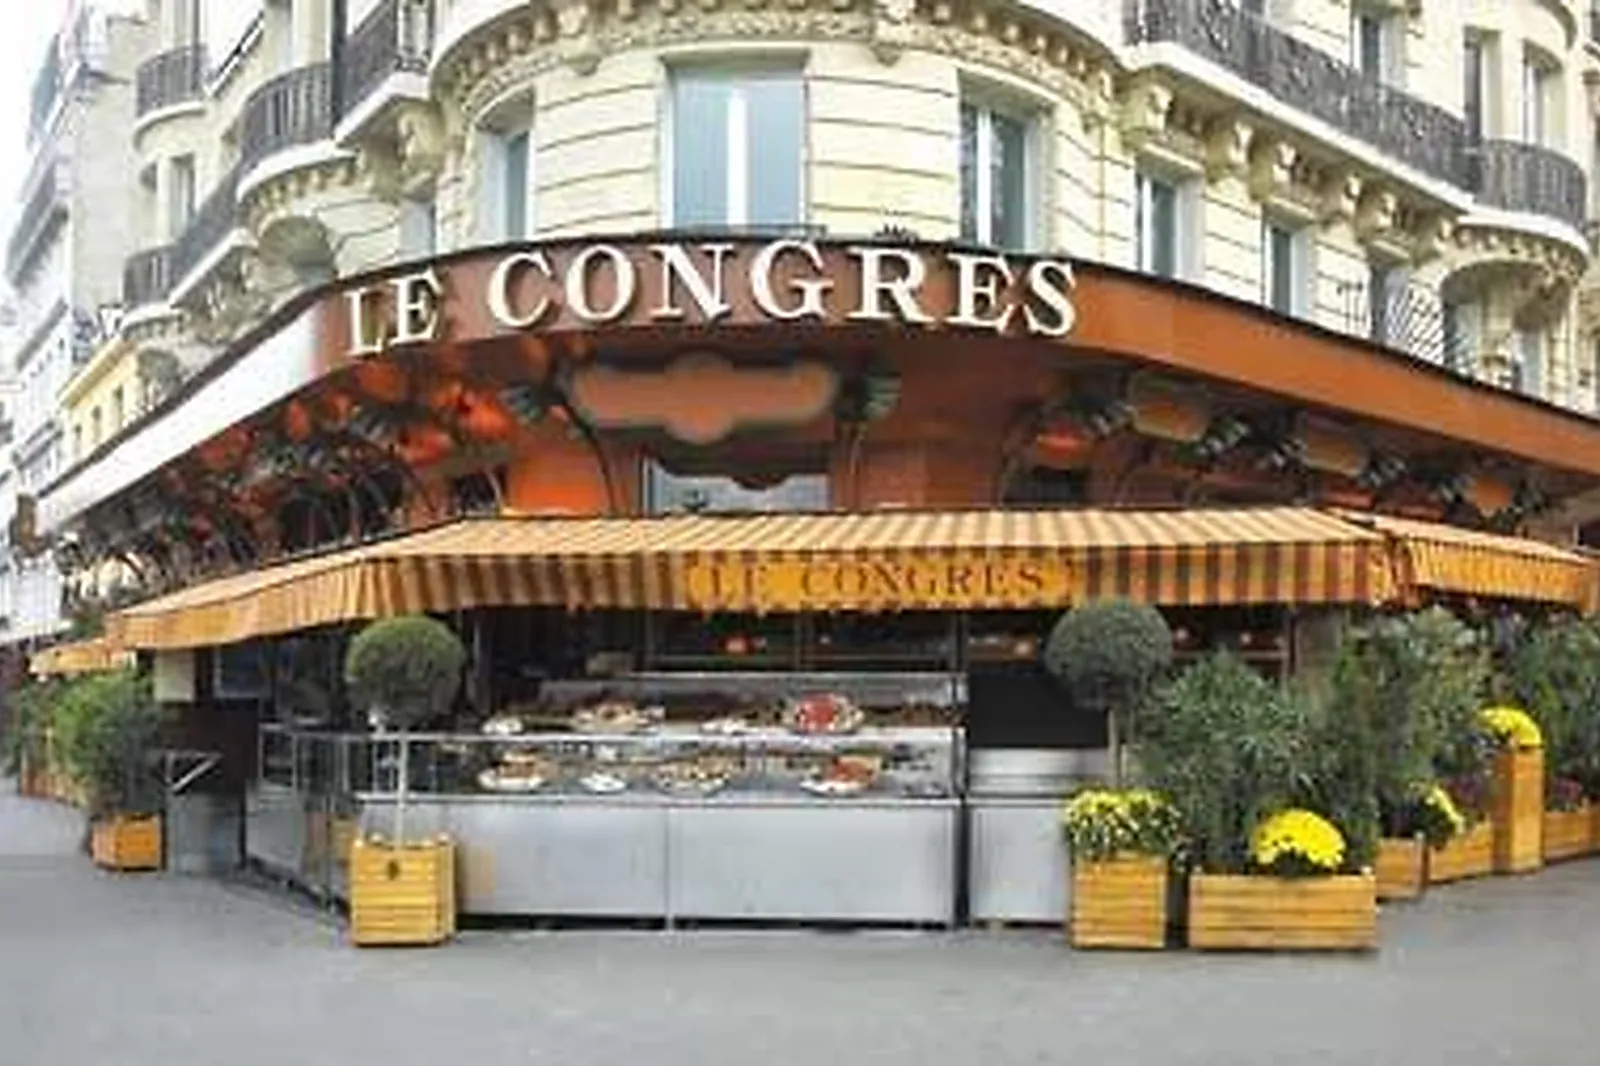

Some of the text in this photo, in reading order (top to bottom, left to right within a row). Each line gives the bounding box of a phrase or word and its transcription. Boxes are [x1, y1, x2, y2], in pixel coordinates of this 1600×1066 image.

[344, 240, 1077, 355] LE CONGRES
[709, 560, 1046, 602] LE CONGRES
